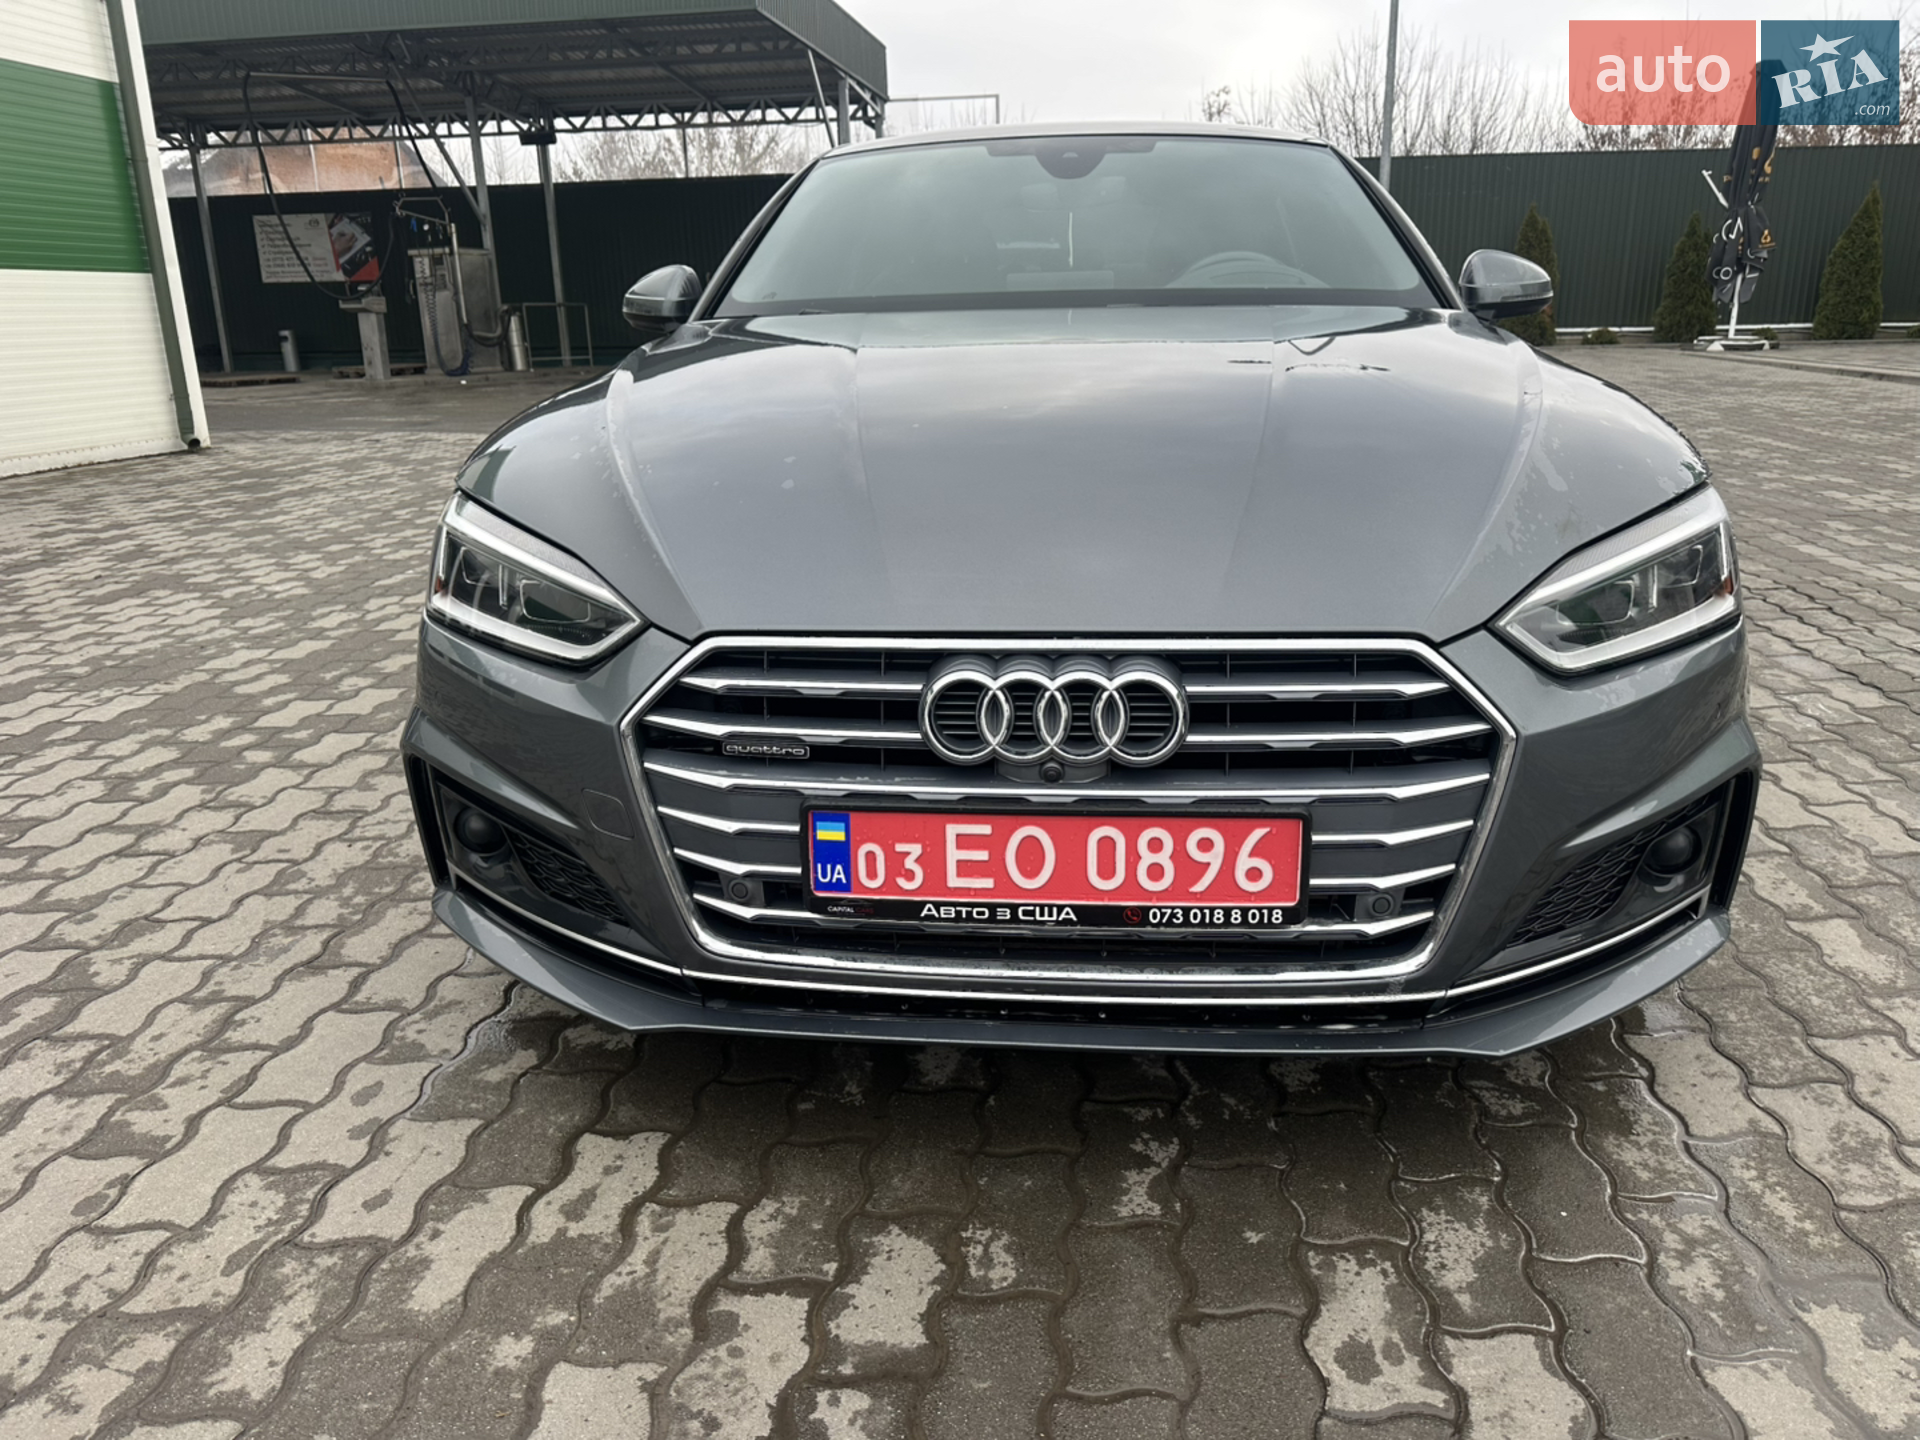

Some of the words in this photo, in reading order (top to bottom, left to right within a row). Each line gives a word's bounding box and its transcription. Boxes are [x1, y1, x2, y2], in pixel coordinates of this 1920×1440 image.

[726, 744, 805, 755] quattro
[857, 842, 924, 891] 03
[945, 824, 1056, 890] EO
[1086, 825, 1274, 893] 0896
[817, 863, 847, 884] UA
[827, 905, 855, 914] CAPITAL
[1018, 906, 1078, 922] США
[1149, 908, 1184, 924] 073
[1189, 908, 1225, 924] 018
[1230, 908, 1241, 924] 8
[1248, 908, 1284, 924] 018
